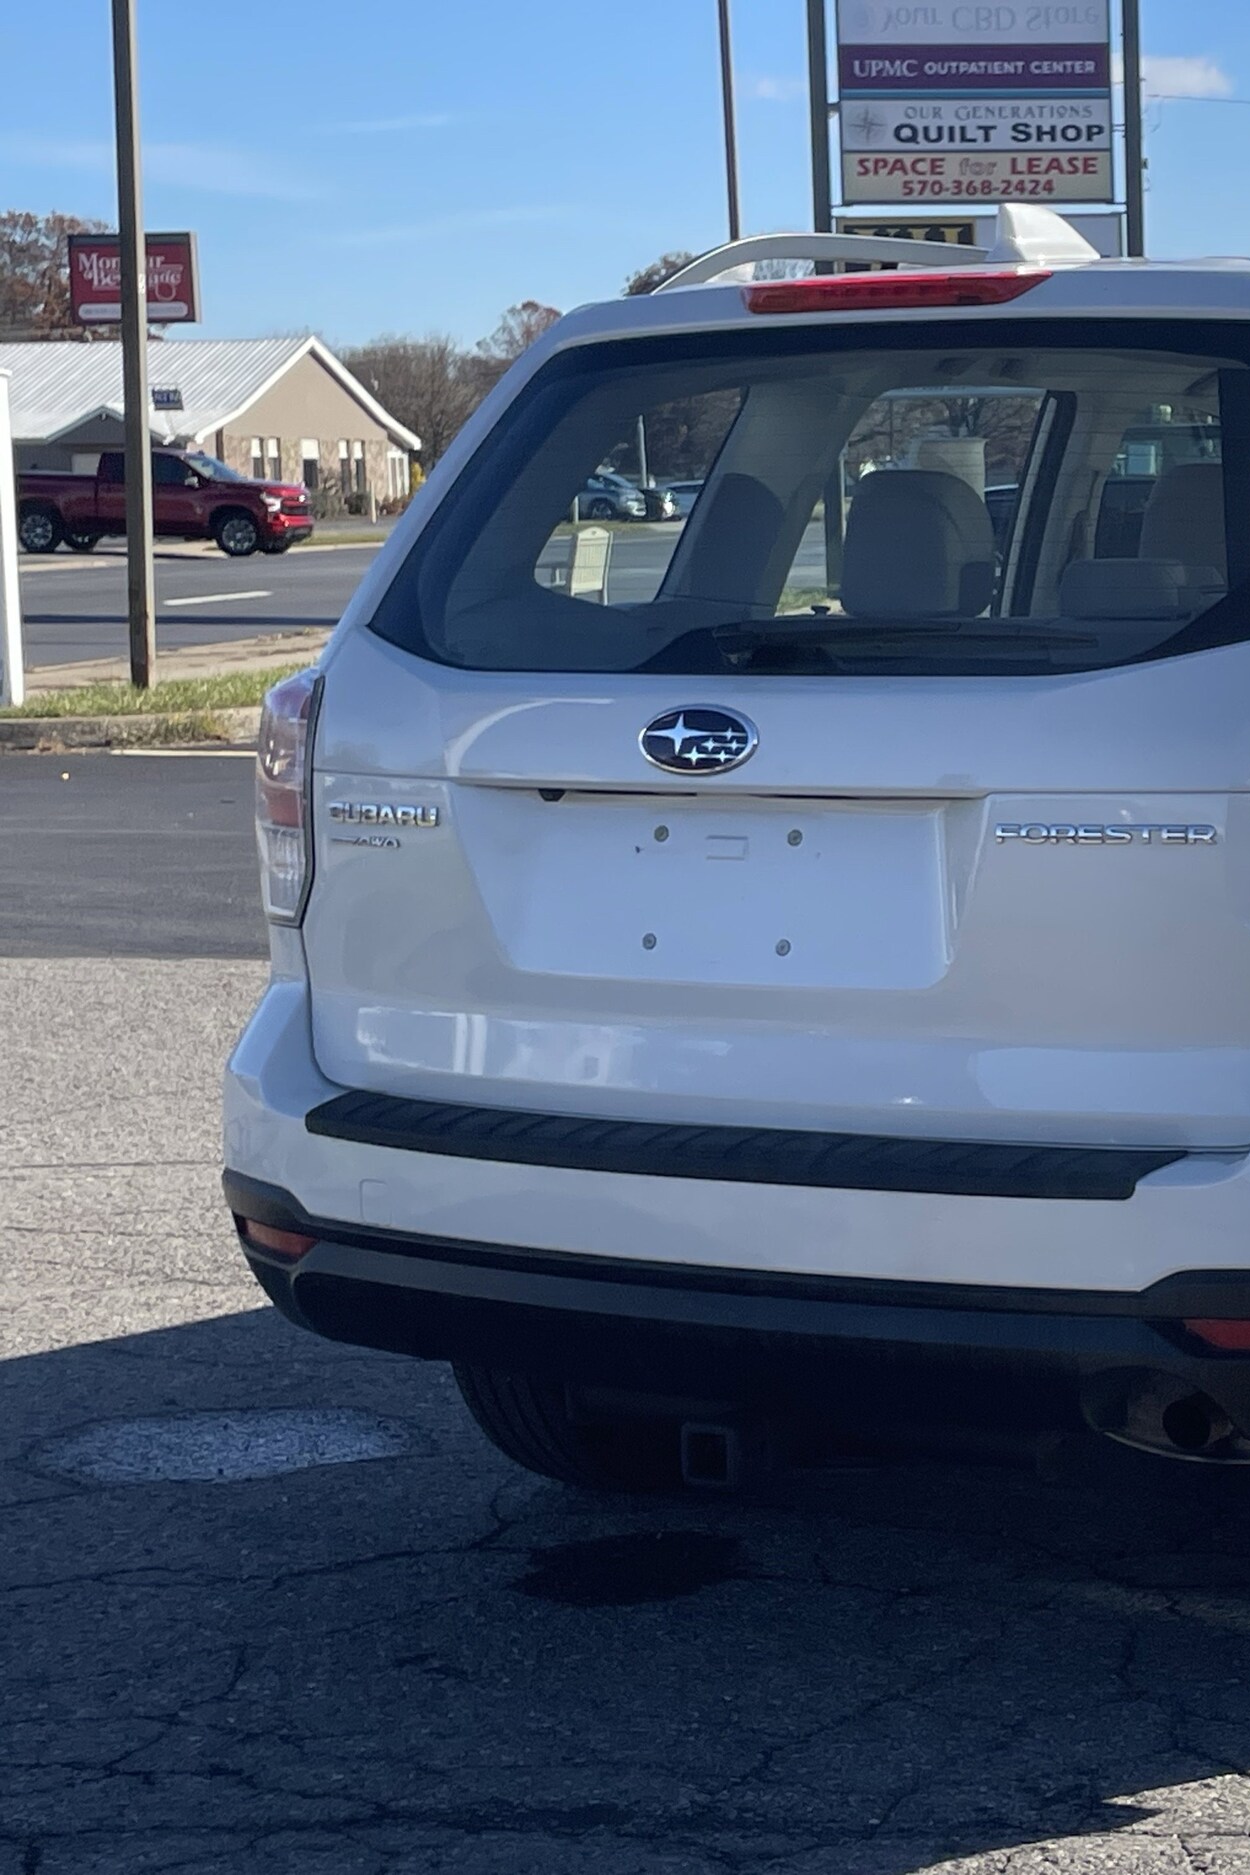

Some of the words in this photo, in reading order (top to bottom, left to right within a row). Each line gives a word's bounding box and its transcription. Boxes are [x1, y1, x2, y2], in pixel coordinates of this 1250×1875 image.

[853, 59, 919, 78] UPMC
[924, 61, 1025, 76] OUTPATIENT
[1029, 61, 1096, 75] CENTER
[904, 106, 943, 120] OUR
[955, 105, 1093, 121] GENERATIONS
[894, 123, 997, 144] QUILT
[1010, 122, 1105, 144] SHOP
[857, 157, 946, 177] SPACE
[959, 157, 997, 176] for
[1010, 156, 1098, 175] LEASE
[902, 179, 1055, 197] 570-368-2424
[329, 802, 438, 828] SUBARU
[995, 822, 1217, 845] FORESTER
